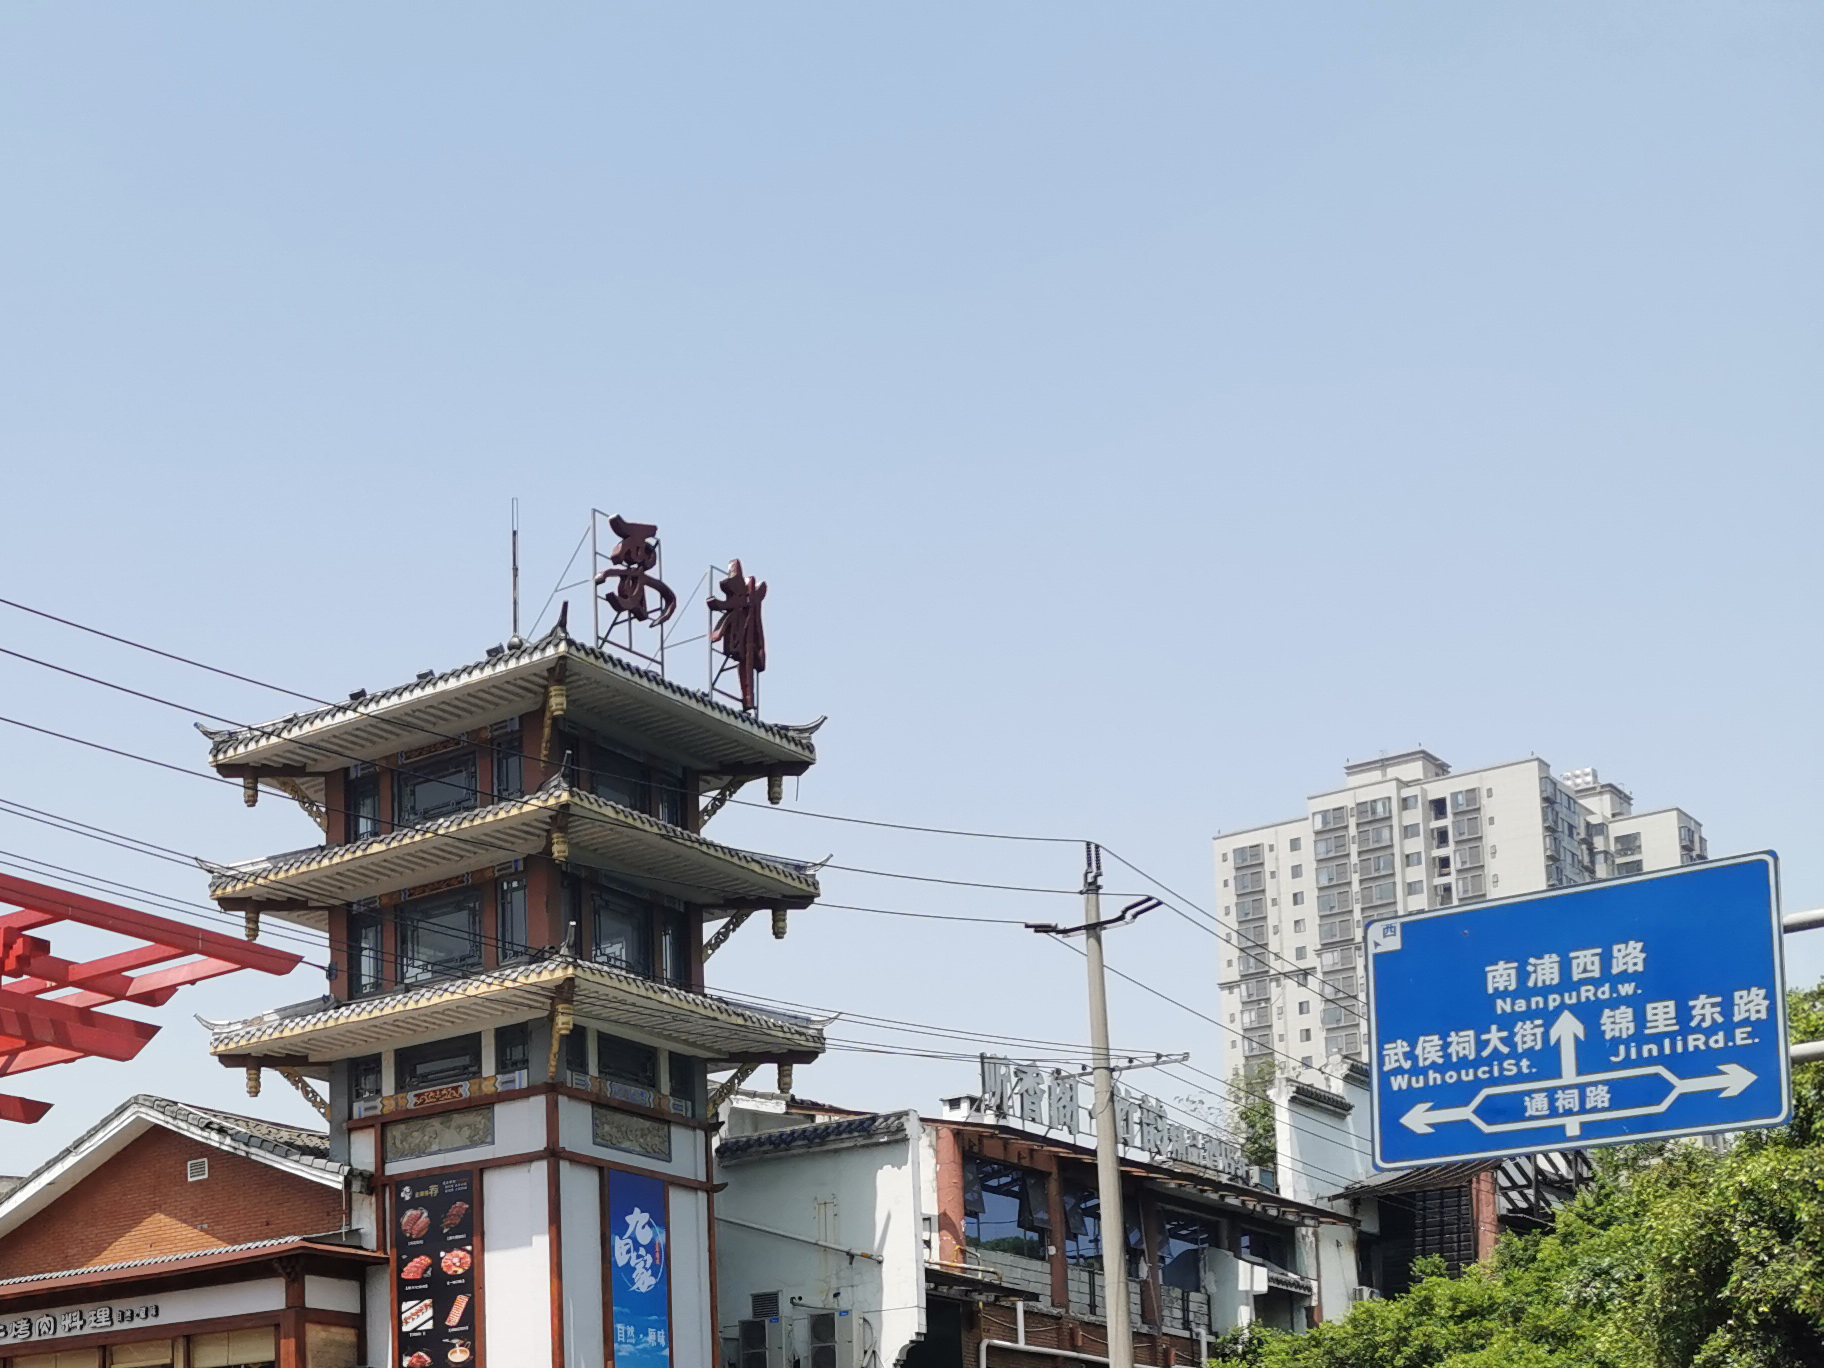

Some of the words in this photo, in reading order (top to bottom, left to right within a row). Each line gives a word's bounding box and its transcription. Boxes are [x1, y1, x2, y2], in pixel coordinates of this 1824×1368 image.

[1383, 923, 1397, 938] 西
[1485, 940, 1647, 994] 南浦西路
[1600, 986, 1770, 1041] 锦里东路
[1382, 1019, 1545, 1073] 武侯祠大街
[1390, 1058, 1538, 1091] WuhouciSt.
[1524, 1084, 1612, 1118] 通祠路
